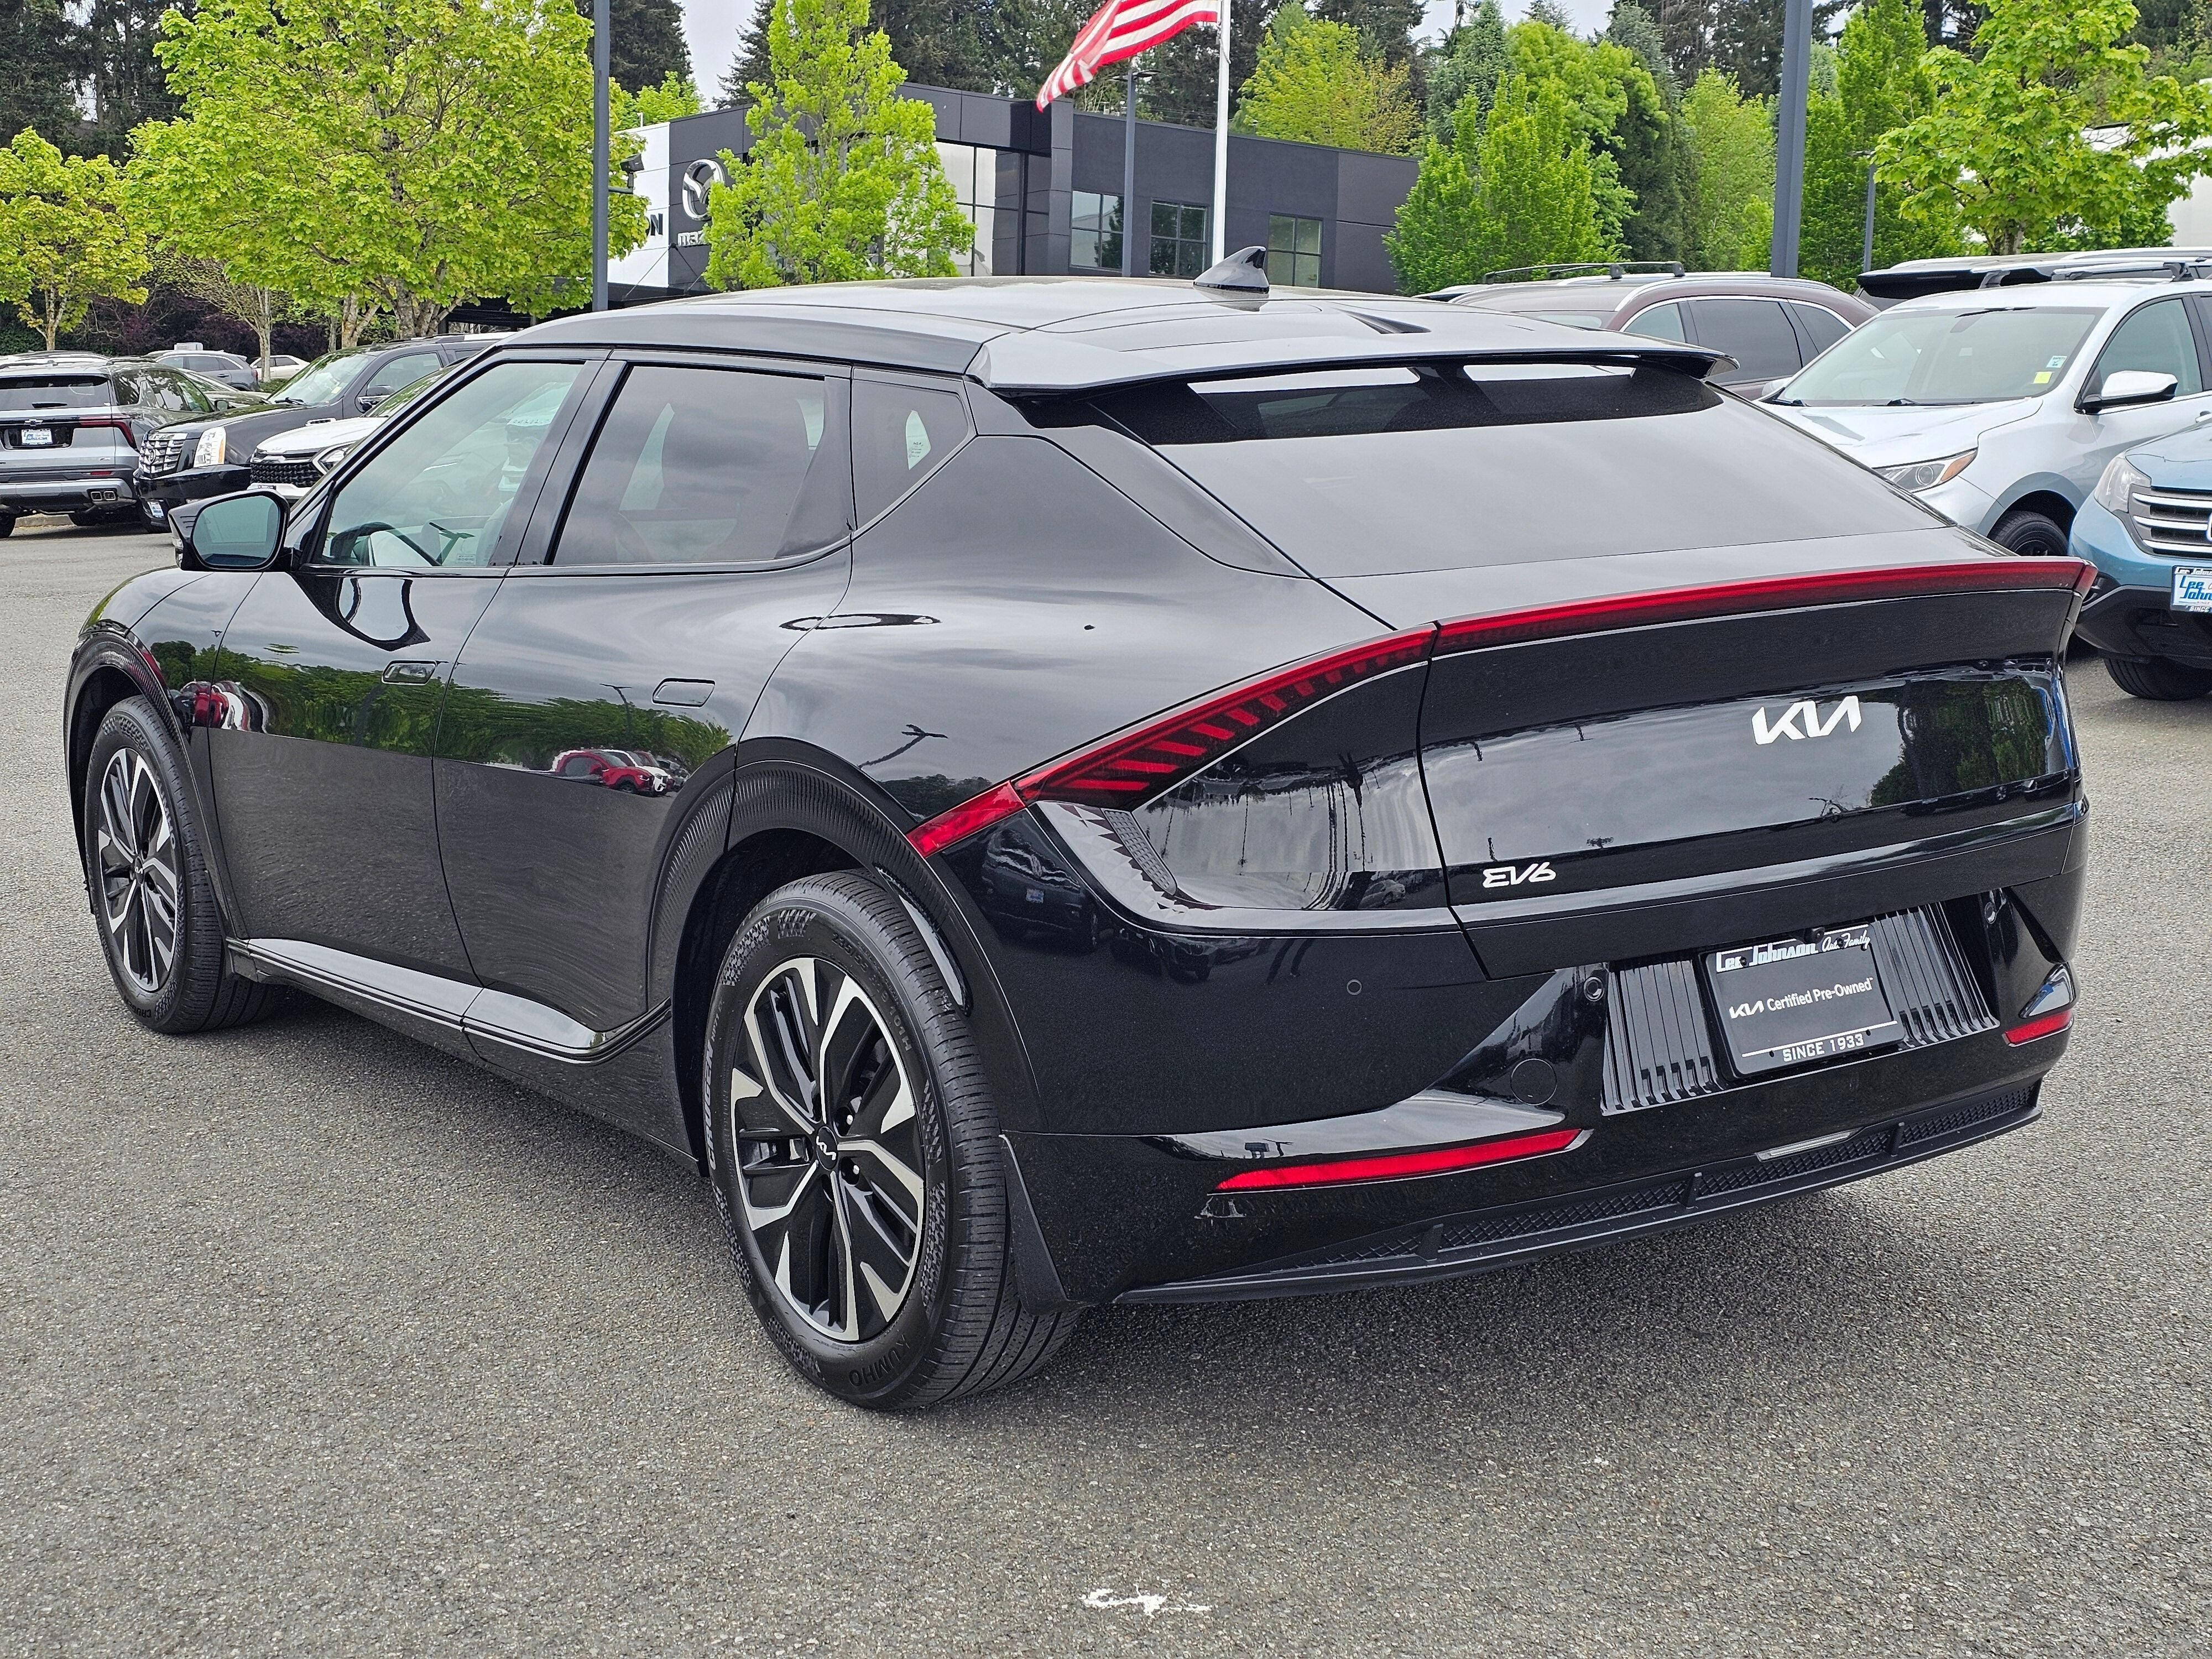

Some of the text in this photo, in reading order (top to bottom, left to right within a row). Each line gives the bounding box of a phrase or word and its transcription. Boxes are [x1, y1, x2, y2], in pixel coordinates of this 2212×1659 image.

[2179, 575, 2204, 589] Lee
[1751, 695, 1862, 745] KIA
[1482, 862, 1557, 888] EV6
[1749, 942, 1819, 966] Johnson
[1840, 929, 1871, 950] Family
[1729, 977, 1873, 1019] KIA Certified Pre-Owned
[1782, 1032, 1864, 1062] SINCE 1933
[705, 1040, 717, 1171] CRUGEN
[849, 1334, 911, 1387] KUMHO
